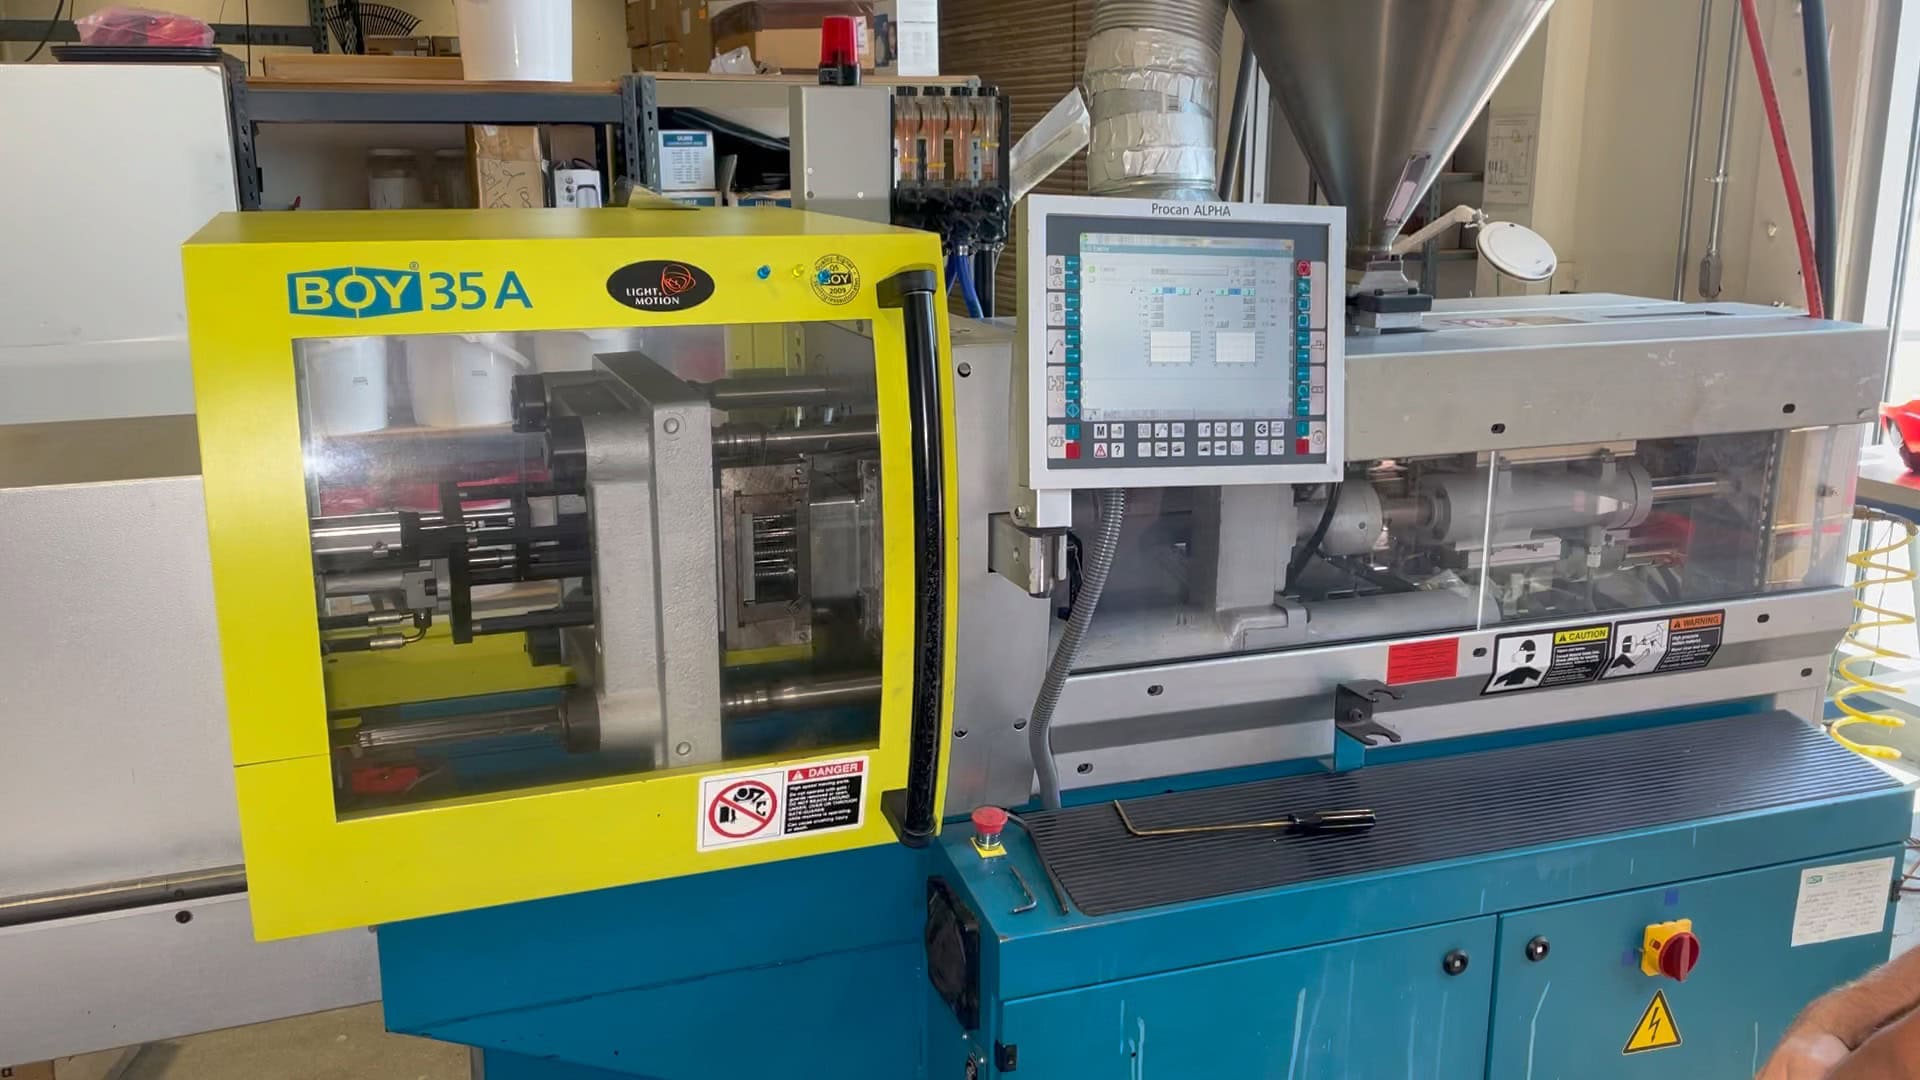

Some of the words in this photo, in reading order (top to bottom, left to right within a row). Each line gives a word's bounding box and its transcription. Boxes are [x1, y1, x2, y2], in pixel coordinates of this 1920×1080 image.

[1152, 202, 1190, 215] Procan
[1194, 204, 1231, 216] ALPHA
[295, 274, 413, 310] BOY
[635, 296, 680, 305] MOTION
[1684, 616, 1718, 626] WARNING
[1568, 630, 1606, 640] CAUTION
[808, 763, 858, 778] DANGER
